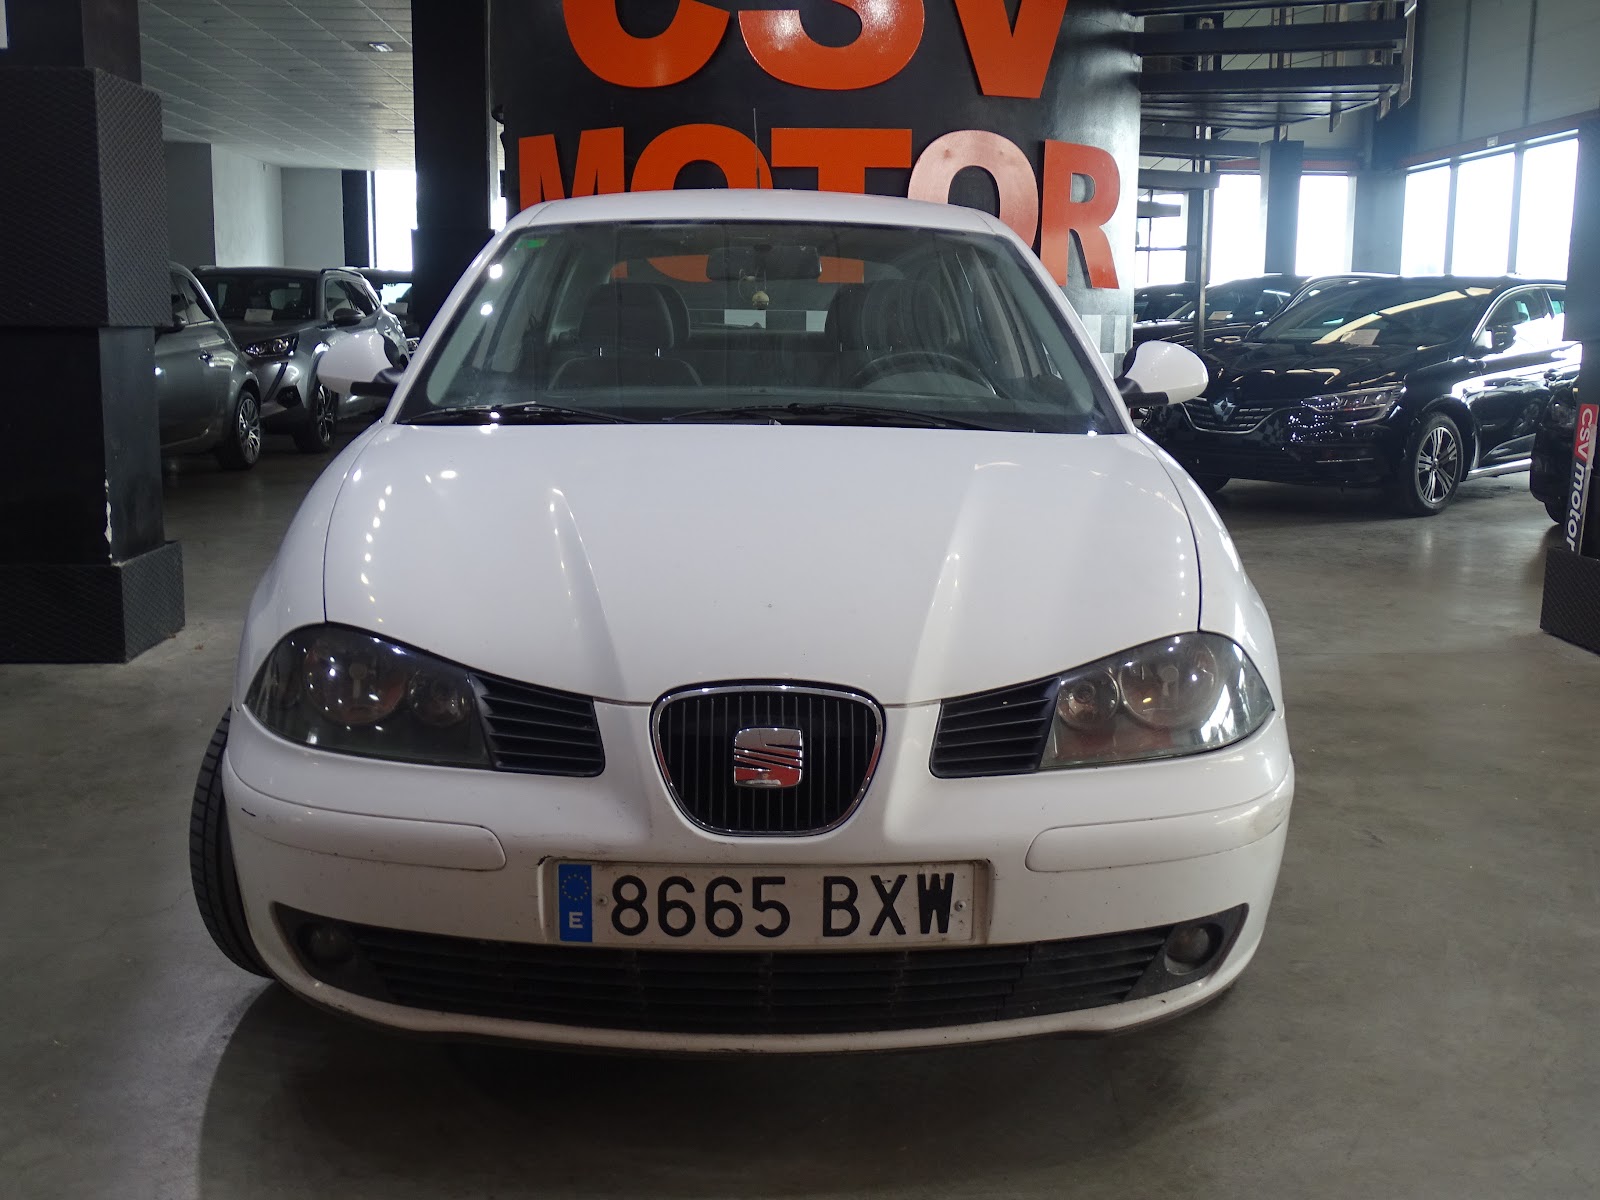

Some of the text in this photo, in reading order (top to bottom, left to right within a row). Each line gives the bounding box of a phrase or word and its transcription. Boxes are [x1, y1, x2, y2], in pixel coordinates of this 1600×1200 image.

[1566, 462, 1585, 552] motor
[567, 911, 583, 929] E
[611, 872, 954, 938] 8665 BXW
